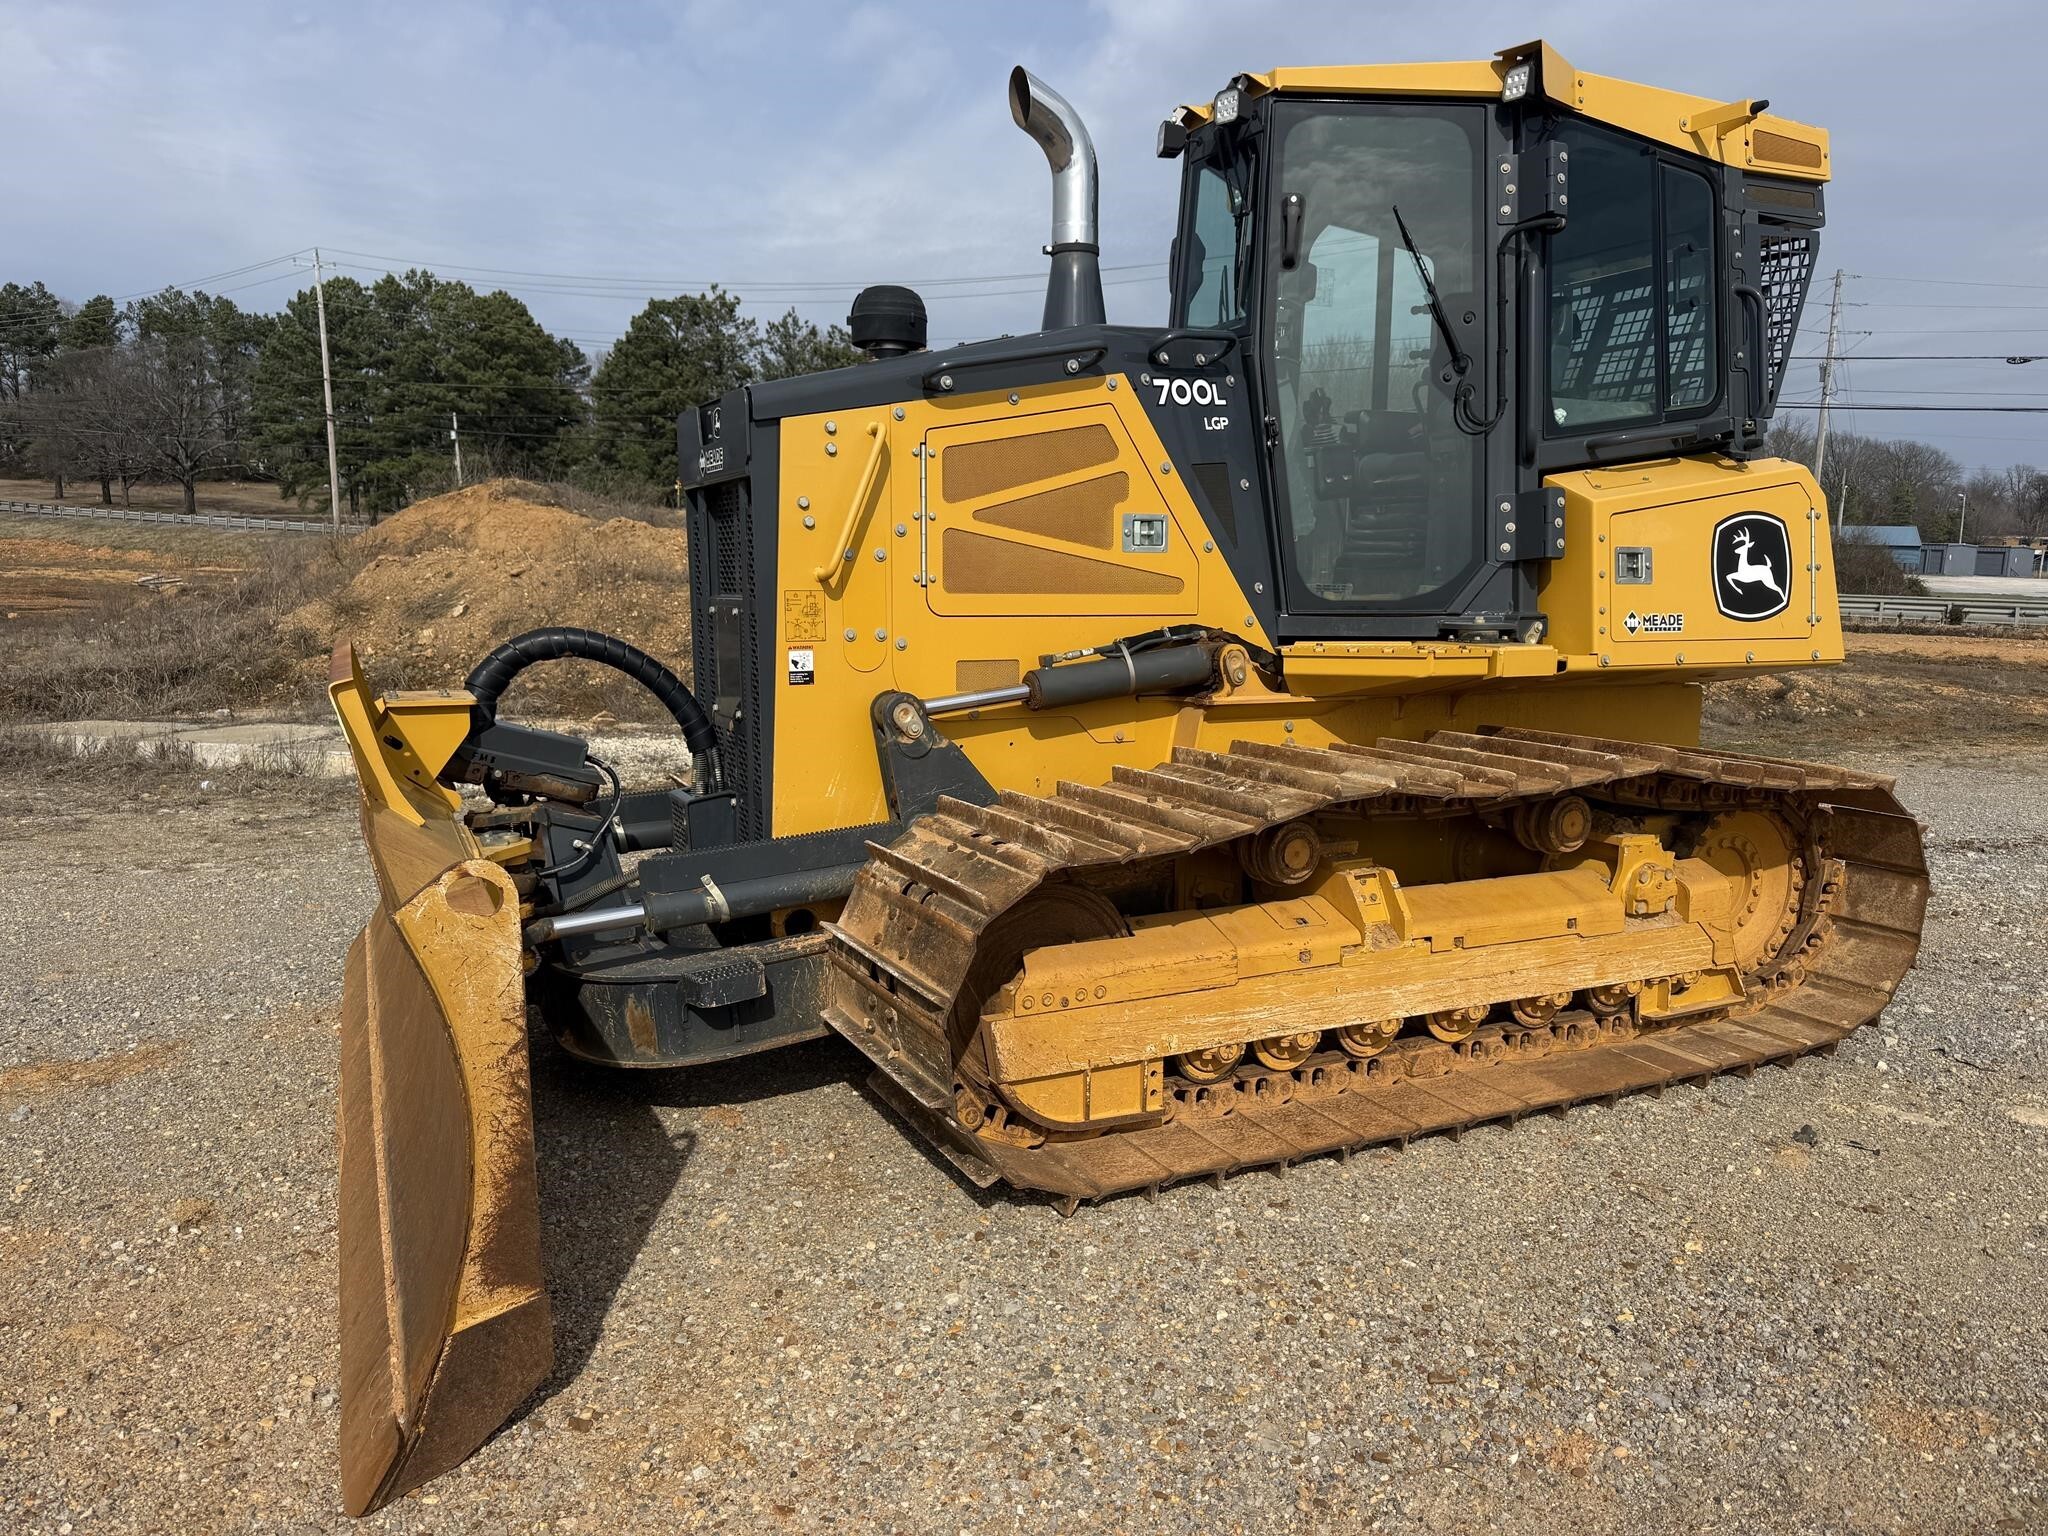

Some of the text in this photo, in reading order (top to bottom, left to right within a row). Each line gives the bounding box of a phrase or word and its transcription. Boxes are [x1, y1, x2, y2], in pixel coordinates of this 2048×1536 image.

[1152, 378, 1227, 405] 700L
[1203, 416, 1229, 431] LGP
[1642, 613, 1683, 626] MEADE
